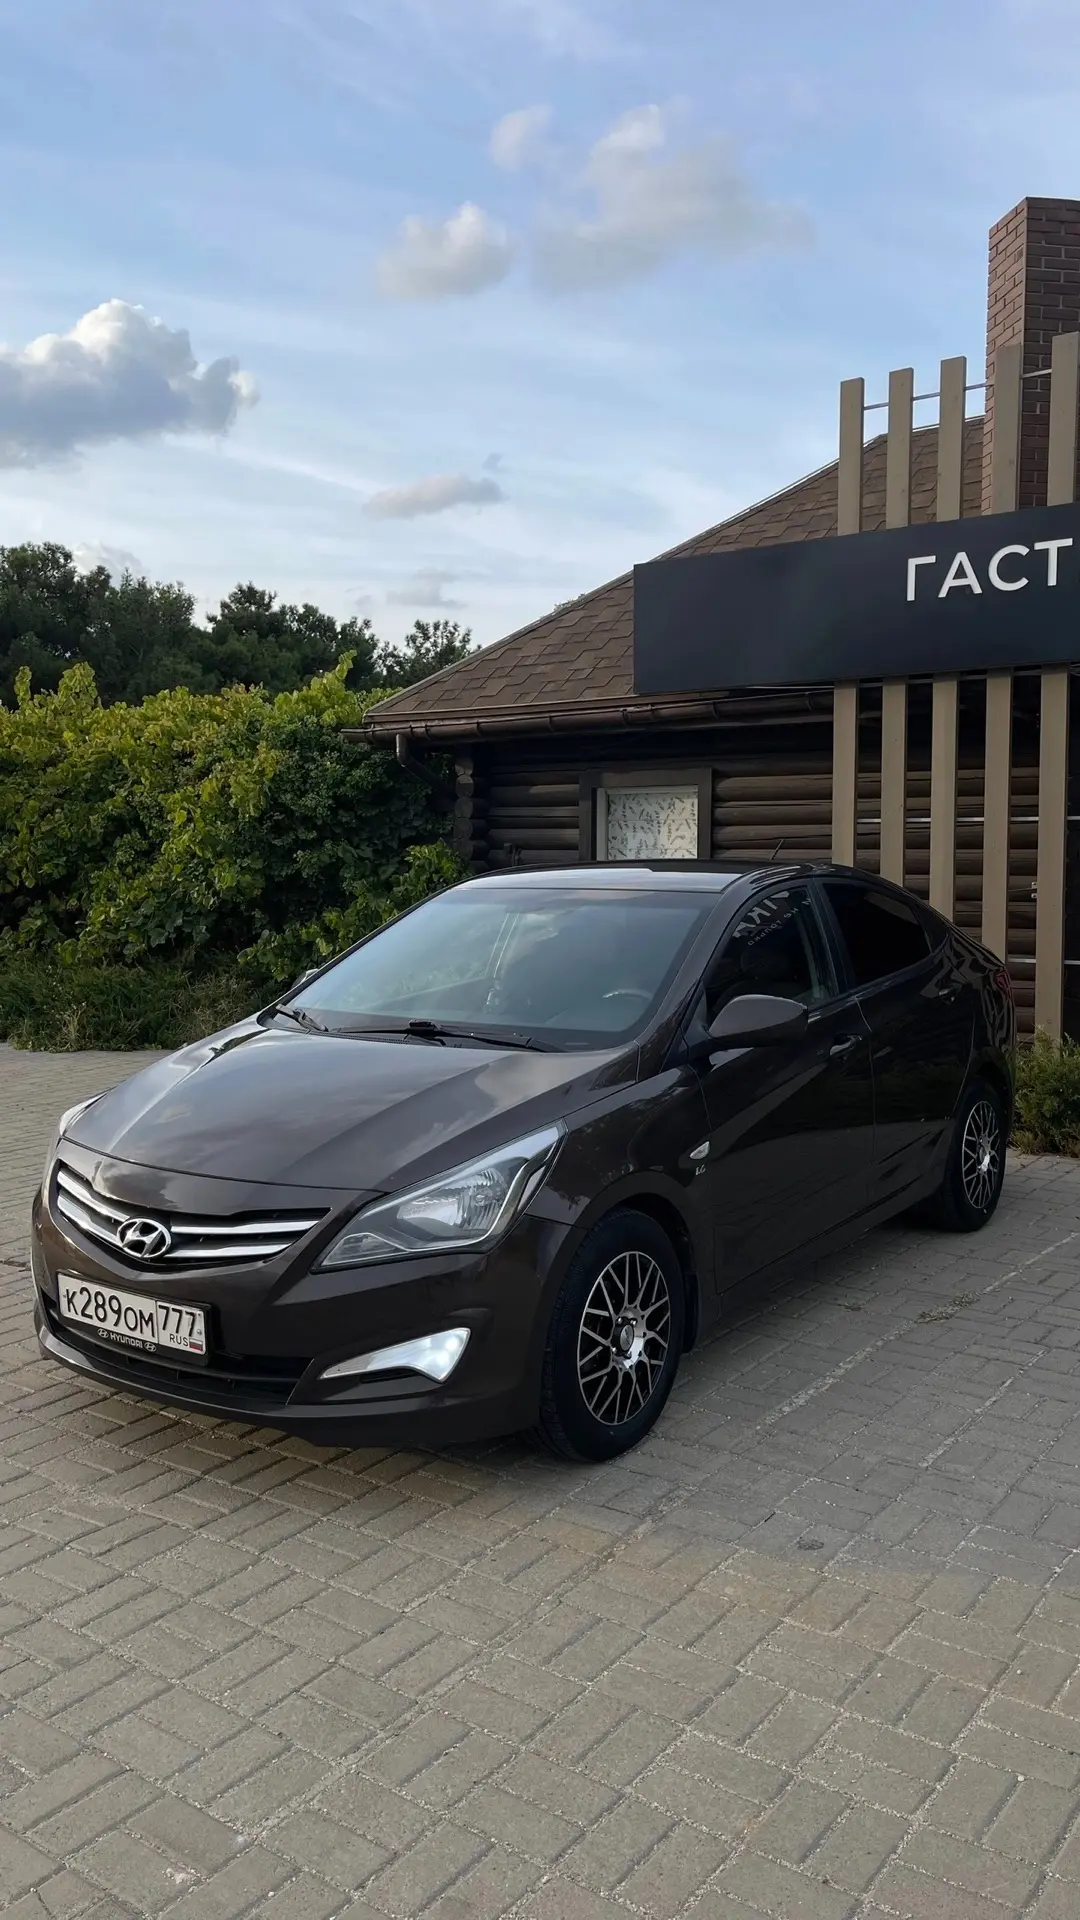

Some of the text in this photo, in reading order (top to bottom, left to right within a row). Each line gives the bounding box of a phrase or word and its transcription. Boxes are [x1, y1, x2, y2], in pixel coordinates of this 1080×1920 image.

[906, 537, 1074, 602] ГАСТ
[110, 1331, 143, 1349] HYUNDAI
[169, 1333, 189, 1347] RUS
